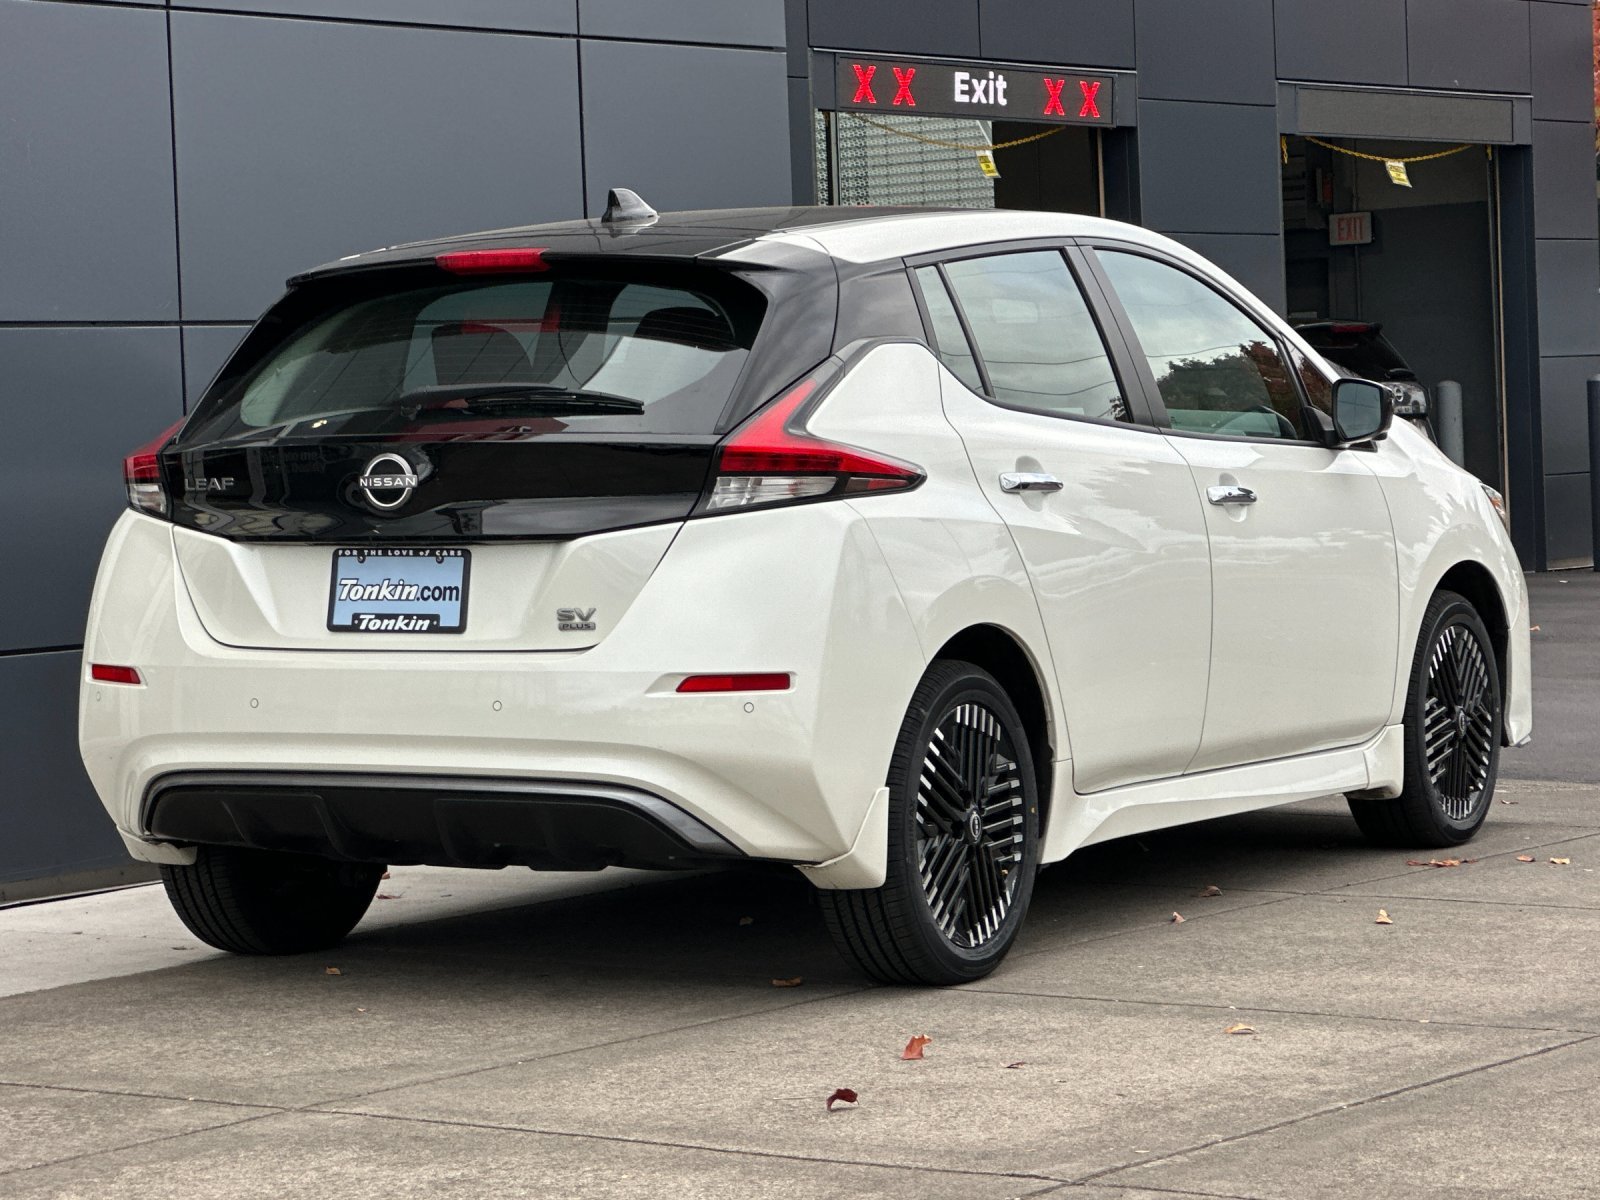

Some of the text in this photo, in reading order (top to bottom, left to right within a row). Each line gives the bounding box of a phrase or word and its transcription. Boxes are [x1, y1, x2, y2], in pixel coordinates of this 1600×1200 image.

[954, 71, 1008, 106] Exit
[1337, 216, 1364, 241] EXIT
[185, 477, 235, 492] LEAF
[360, 475, 417, 489] NISSAN
[338, 578, 460, 602] Tonkin.com
[359, 614, 430, 631] Tonkin
[556, 607, 597, 622] SV
